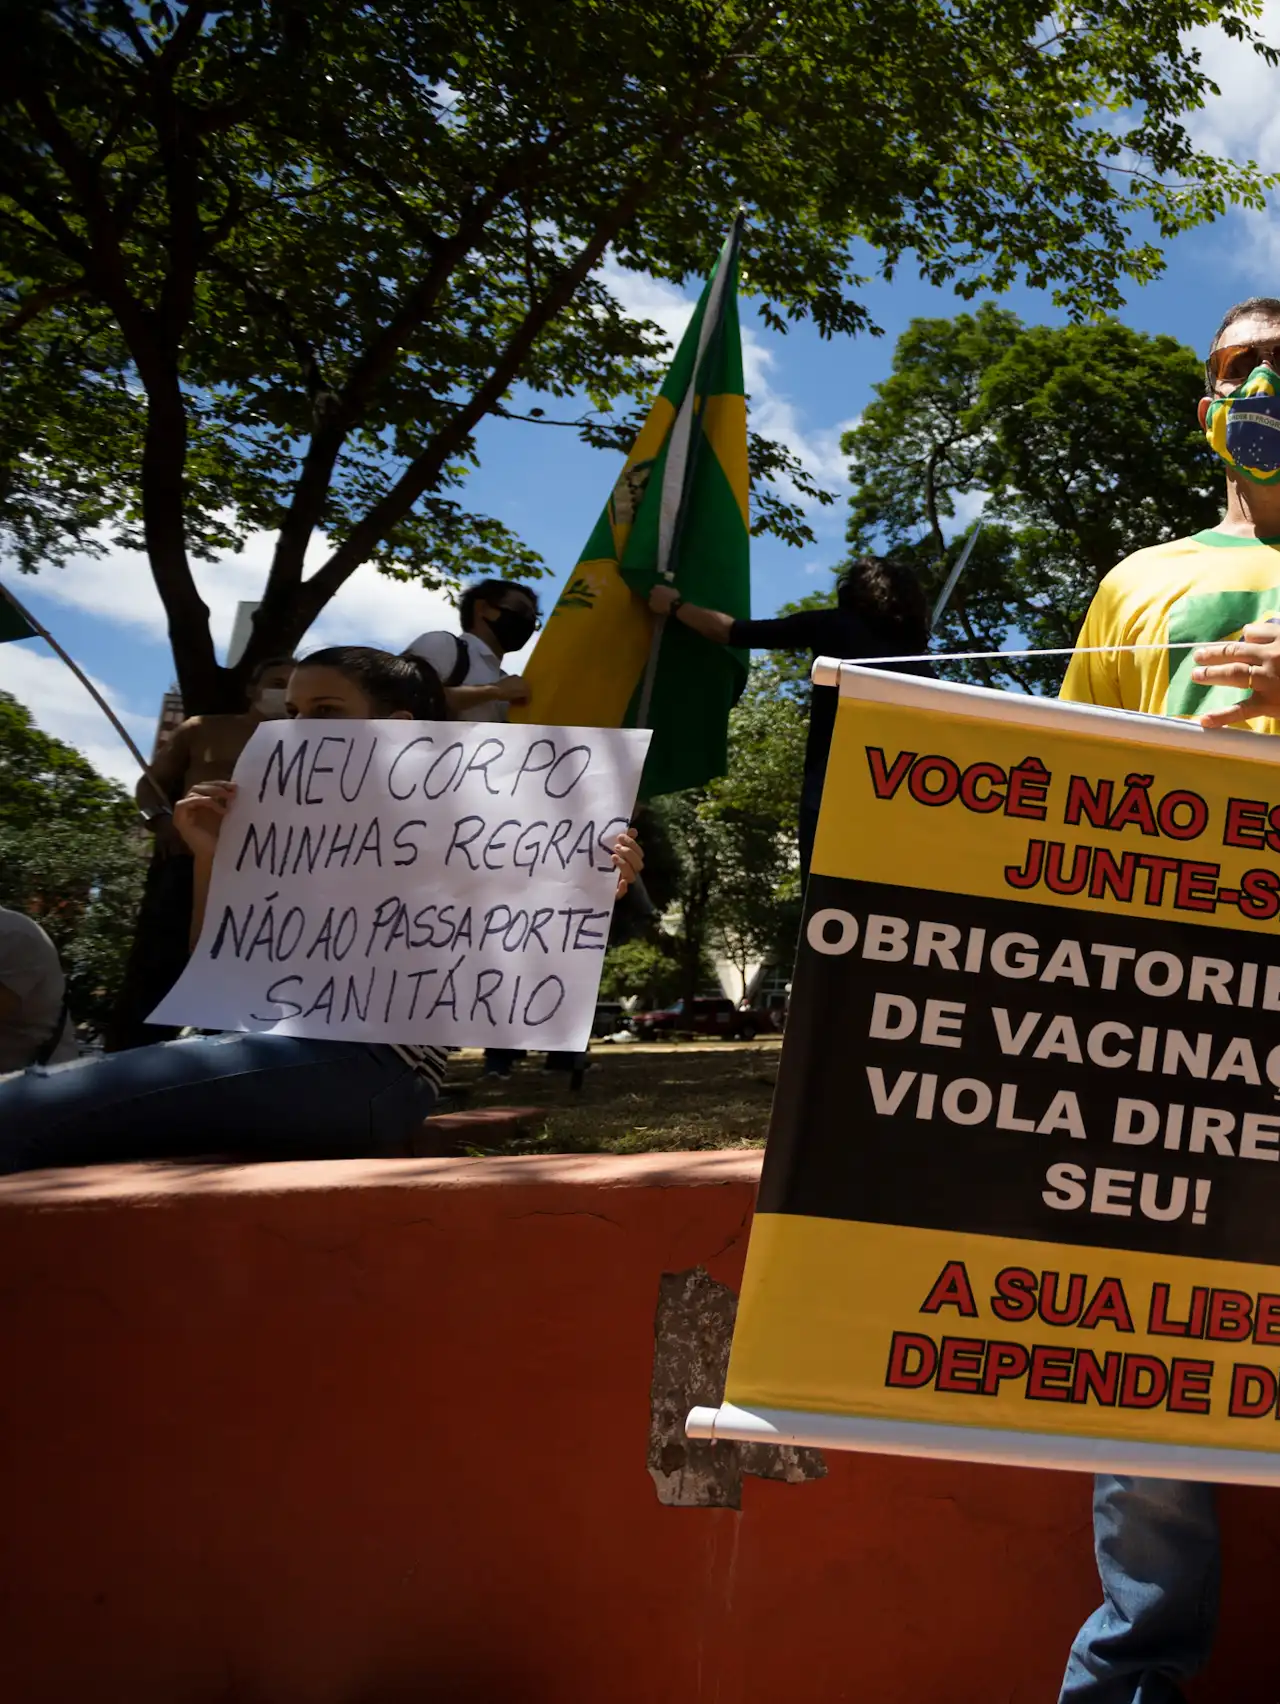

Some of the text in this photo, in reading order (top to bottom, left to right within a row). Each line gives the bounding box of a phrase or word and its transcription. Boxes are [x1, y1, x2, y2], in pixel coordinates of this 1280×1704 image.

[258, 736, 591, 805] MEU CORPO
[865, 746, 1052, 821] VOCÊ
[1064, 773, 1209, 841] NÃO
[236, 815, 631, 877] MINHAS REGRAS
[306, 906, 358, 961] AO
[364, 896, 611, 957] PASSAPORTE
[250, 954, 566, 1026] SANITÁRIO
[868, 992, 967, 1049] DE
[865, 1066, 1087, 1140] VIOLA
[1042, 1162, 1212, 1225] SEU!
[919, 1260, 979, 1317] A
[990, 1266, 1135, 1333] SUA
[885, 1331, 1214, 1415] DEPENDE
